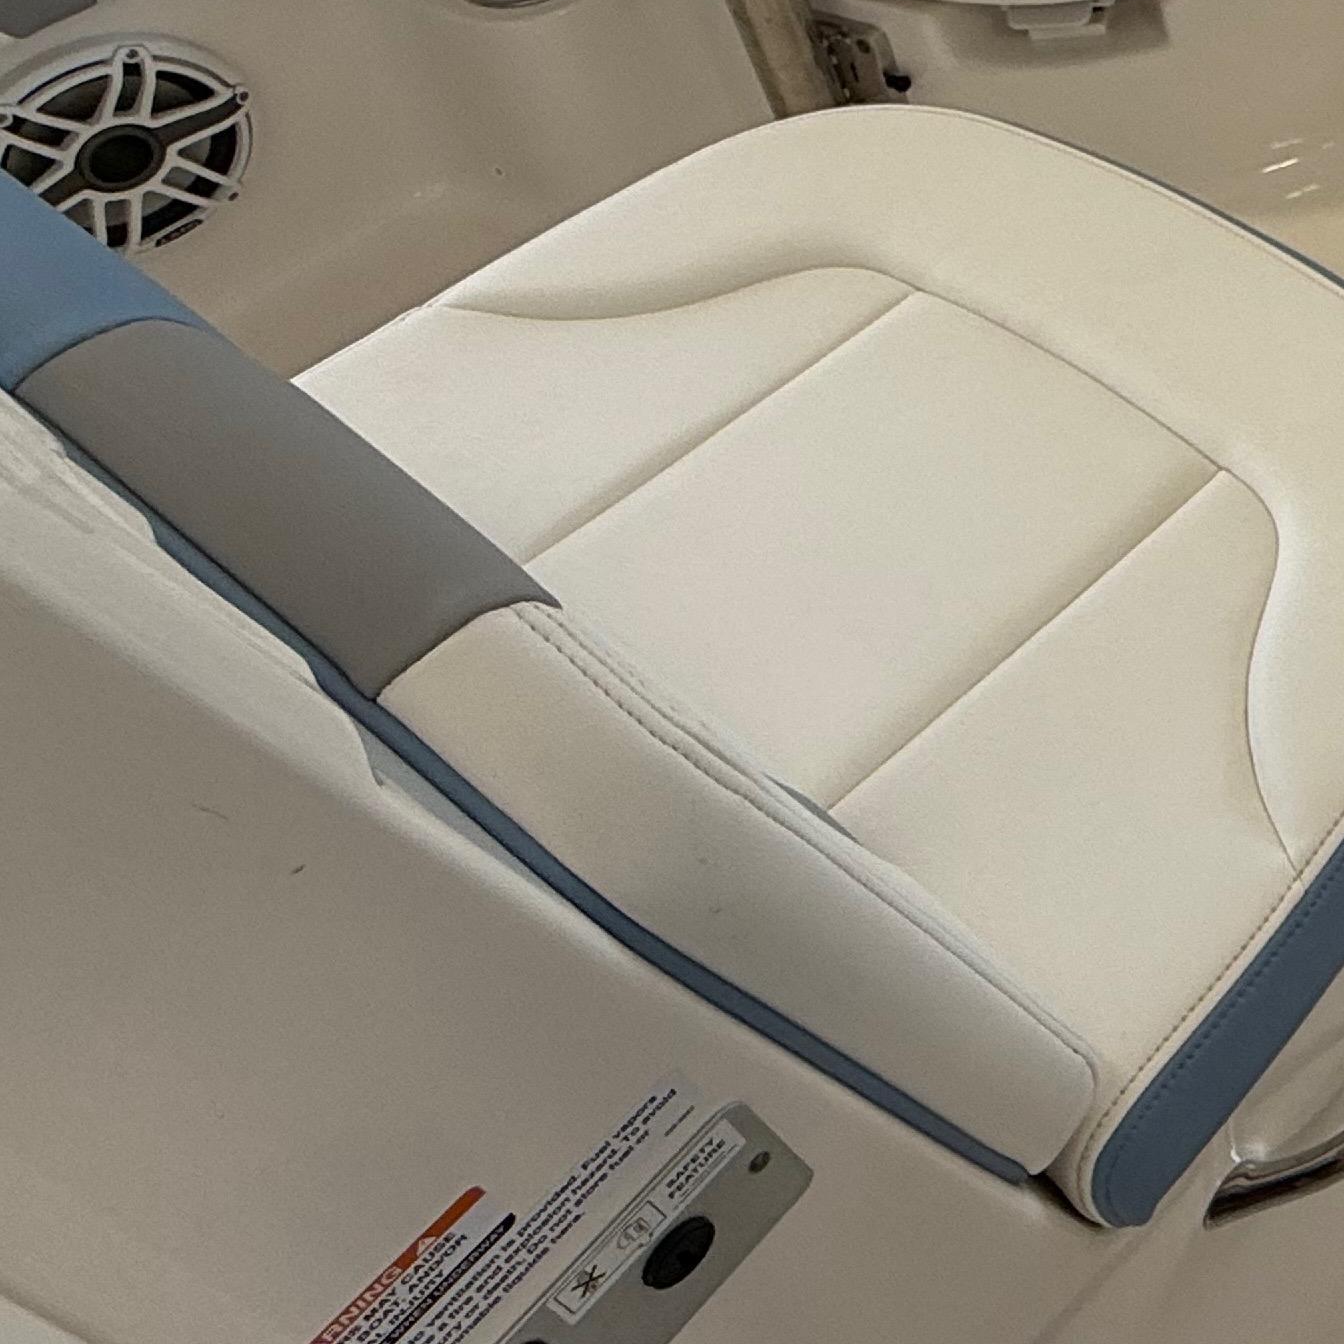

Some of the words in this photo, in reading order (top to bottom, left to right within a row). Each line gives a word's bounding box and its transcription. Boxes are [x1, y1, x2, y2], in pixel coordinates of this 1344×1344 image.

[664, 1137, 716, 1188] SAFETY
[666, 1138, 727, 1199] FEATURE
[424, 1252, 501, 1329] ventilation
[580, 1139, 611, 1170] Fuel
[611, 1094, 657, 1140] vapors
[447, 1293, 474, 1320] fire
[473, 1264, 502, 1293] and
[502, 1195, 571, 1264] explosion
[620, 1124, 640, 1145] To
[639, 1087, 677, 1125] avoid
[464, 1302, 480, 1319] or
[526, 1232, 548, 1254] Do
[548, 1208, 572, 1232] not
[572, 1171, 608, 1207] store
[608, 1144, 634, 1170] fuel
[634, 1129, 650, 1144] or
[362, 1286, 399, 1323] MAY
[399, 1230, 456, 1286] CAUSE
[388, 1268, 445, 1326] INJURY
[432, 1224, 506, 1298] UNDERWAY
[501, 1245, 550, 1294] liquids
[320, 1262, 403, 1344] RNING
